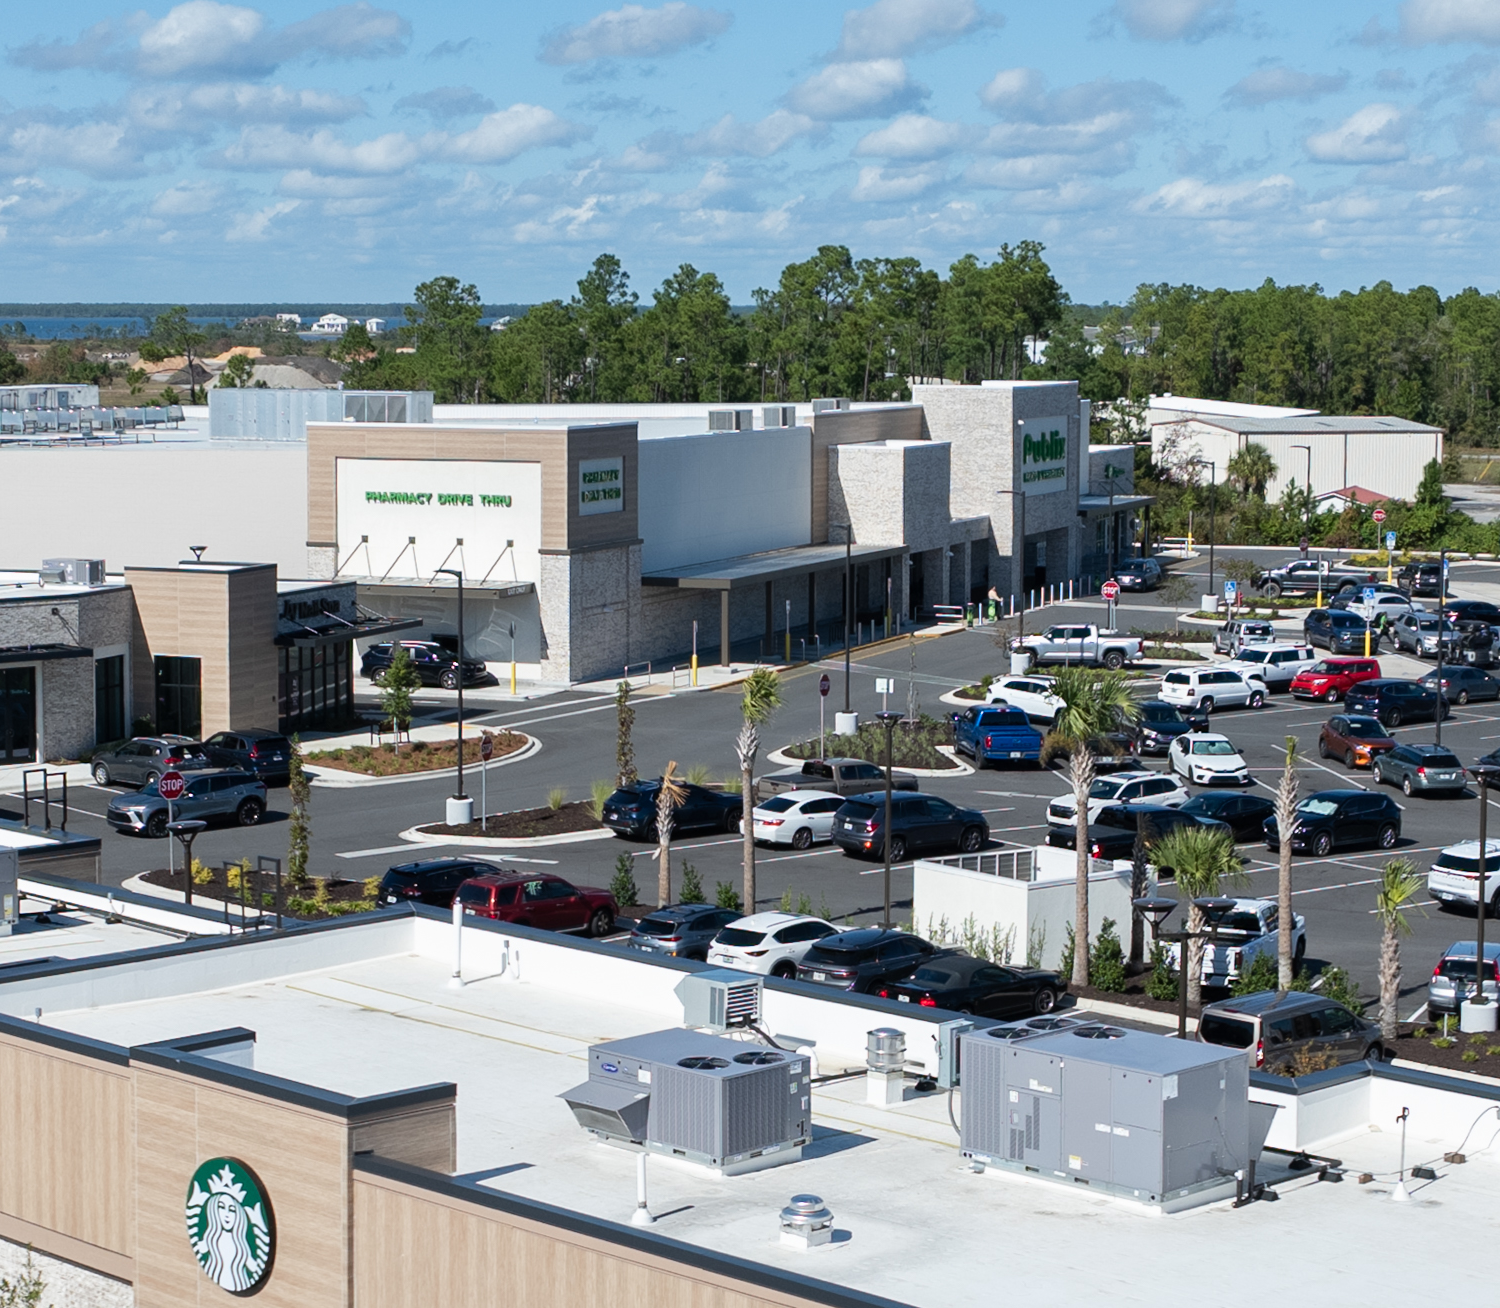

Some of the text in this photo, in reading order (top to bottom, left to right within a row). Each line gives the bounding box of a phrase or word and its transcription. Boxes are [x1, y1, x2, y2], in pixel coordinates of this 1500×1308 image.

[1023, 430, 1066, 465] Publix
[365, 491, 512, 508] PHARMACY DRIVE THRU
[161, 779, 183, 792] STOP
